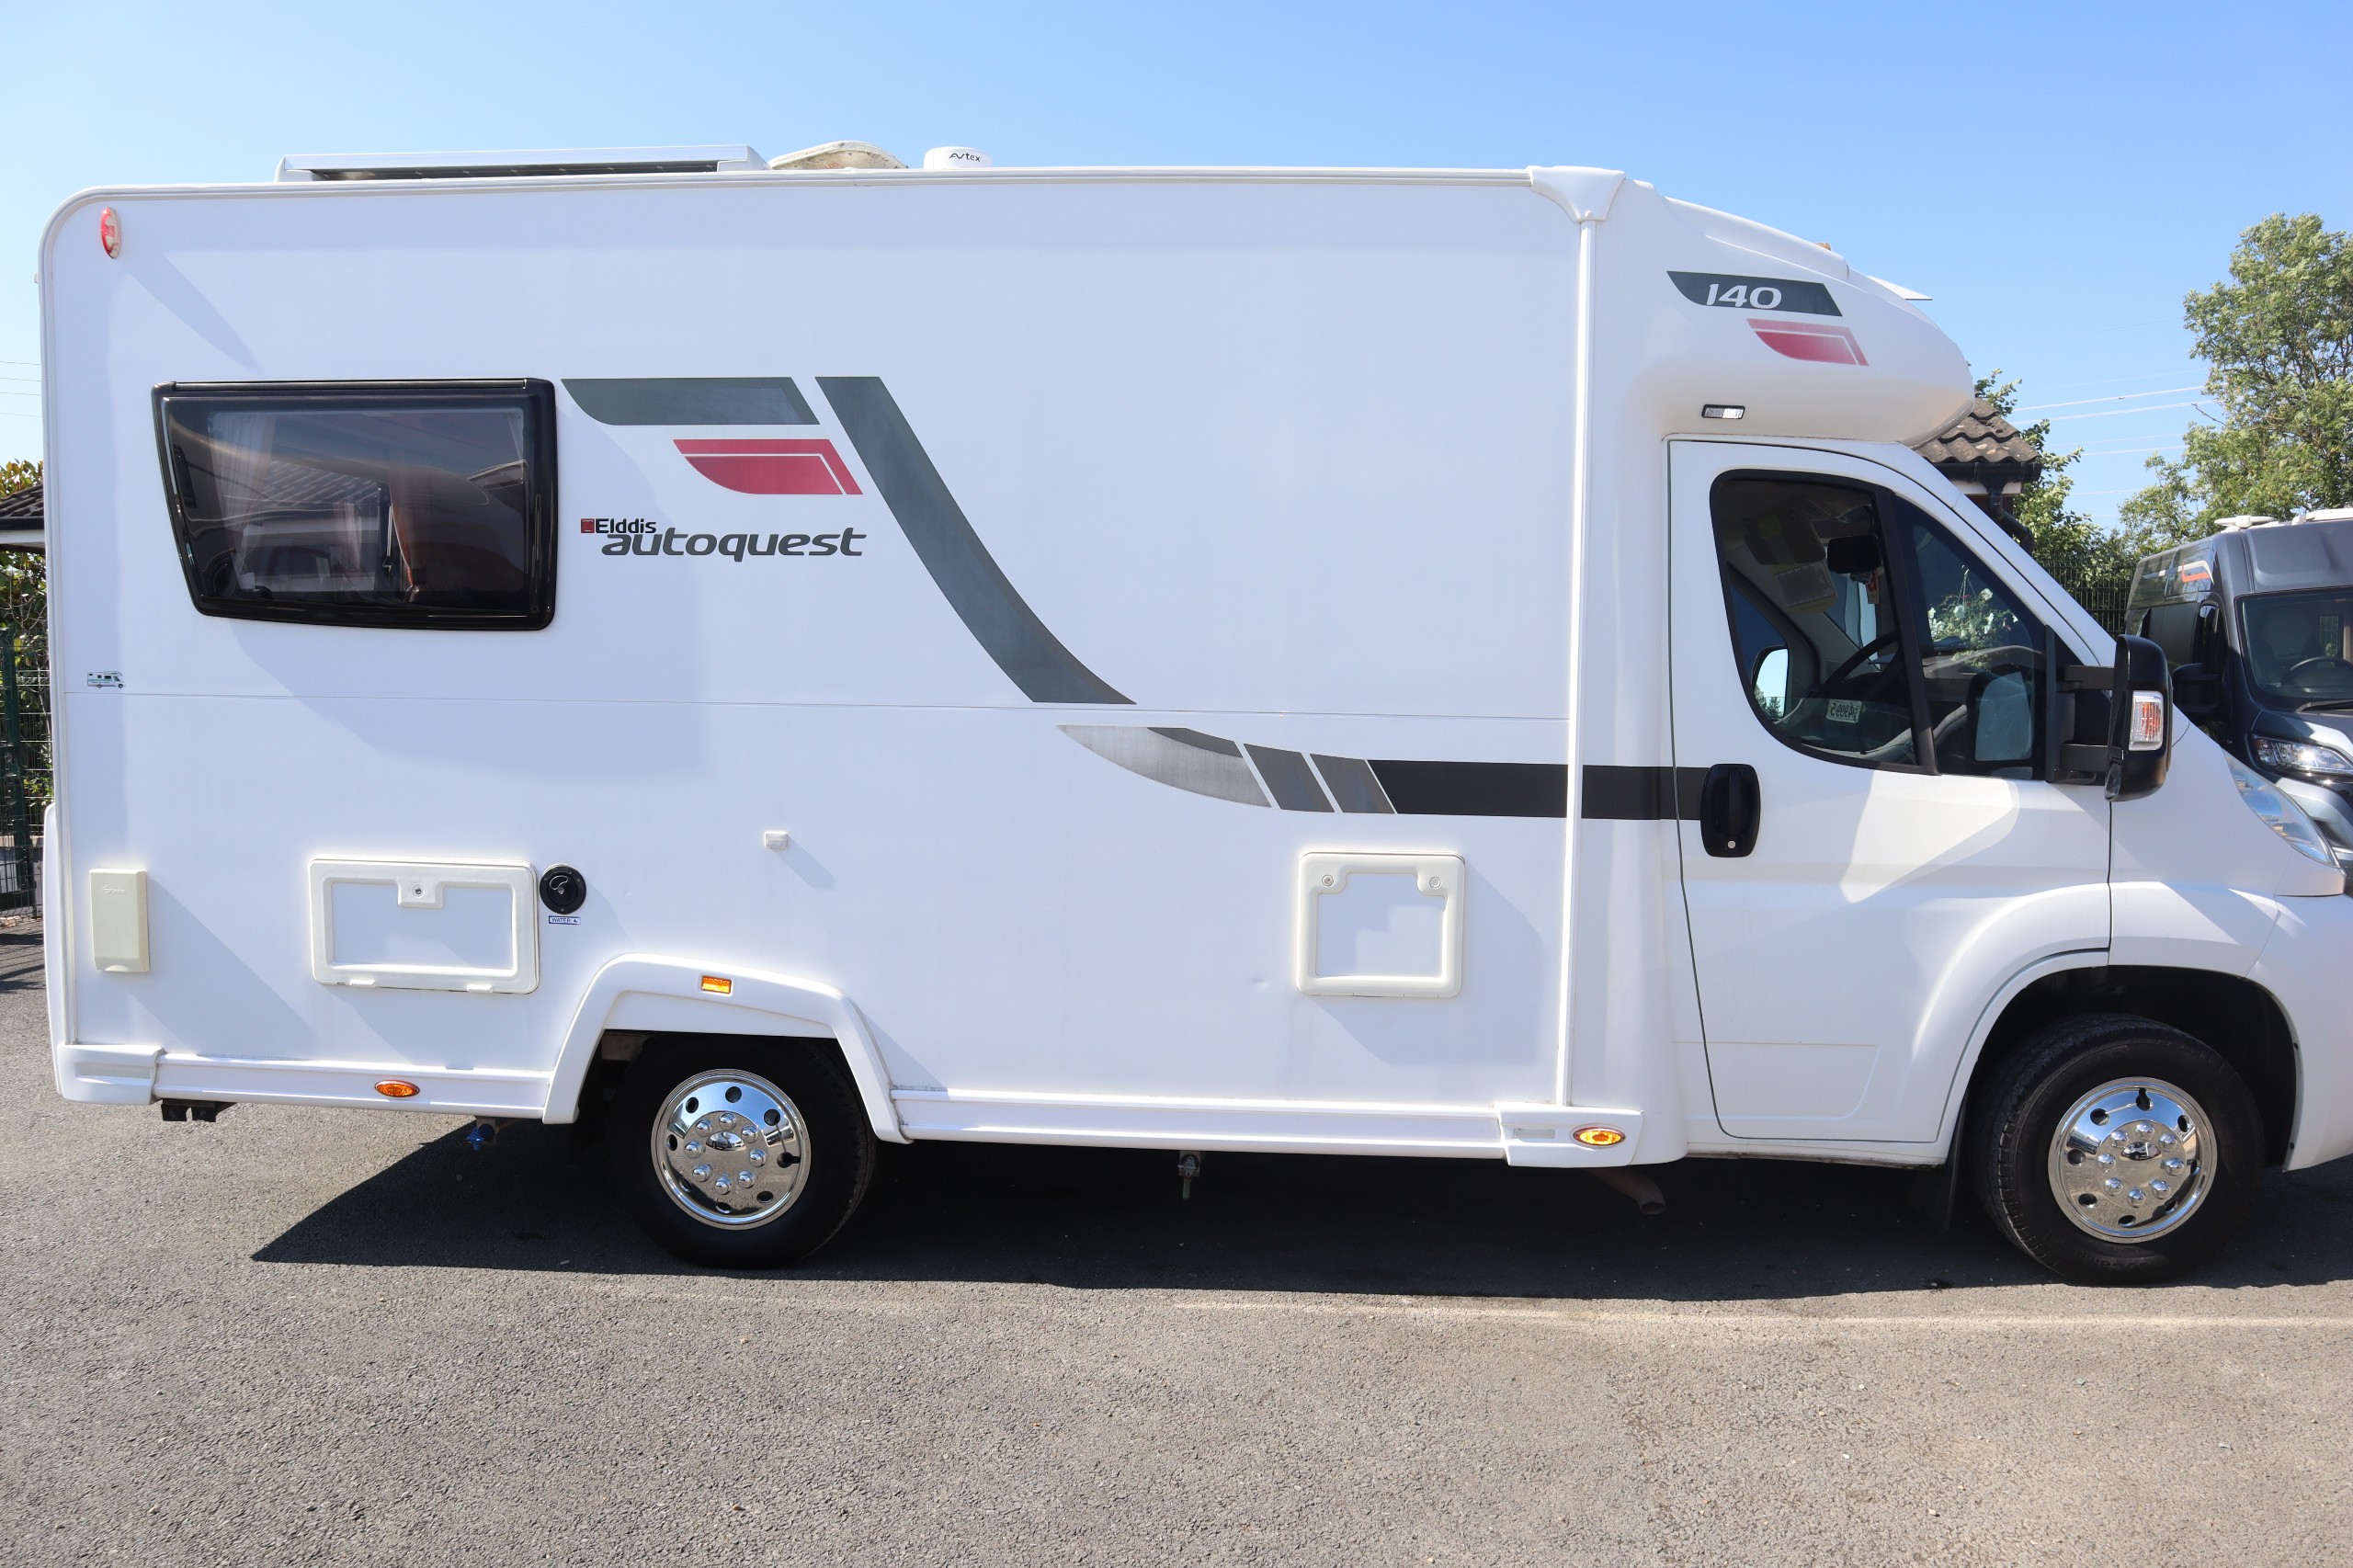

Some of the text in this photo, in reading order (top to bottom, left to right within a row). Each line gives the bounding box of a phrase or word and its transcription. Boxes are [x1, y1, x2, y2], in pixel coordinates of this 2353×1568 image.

[949, 153, 981, 163] Avtex
[1706, 283, 1782, 310] 140
[596, 518, 657, 534] Elddis
[601, 527, 868, 562] autoquest
